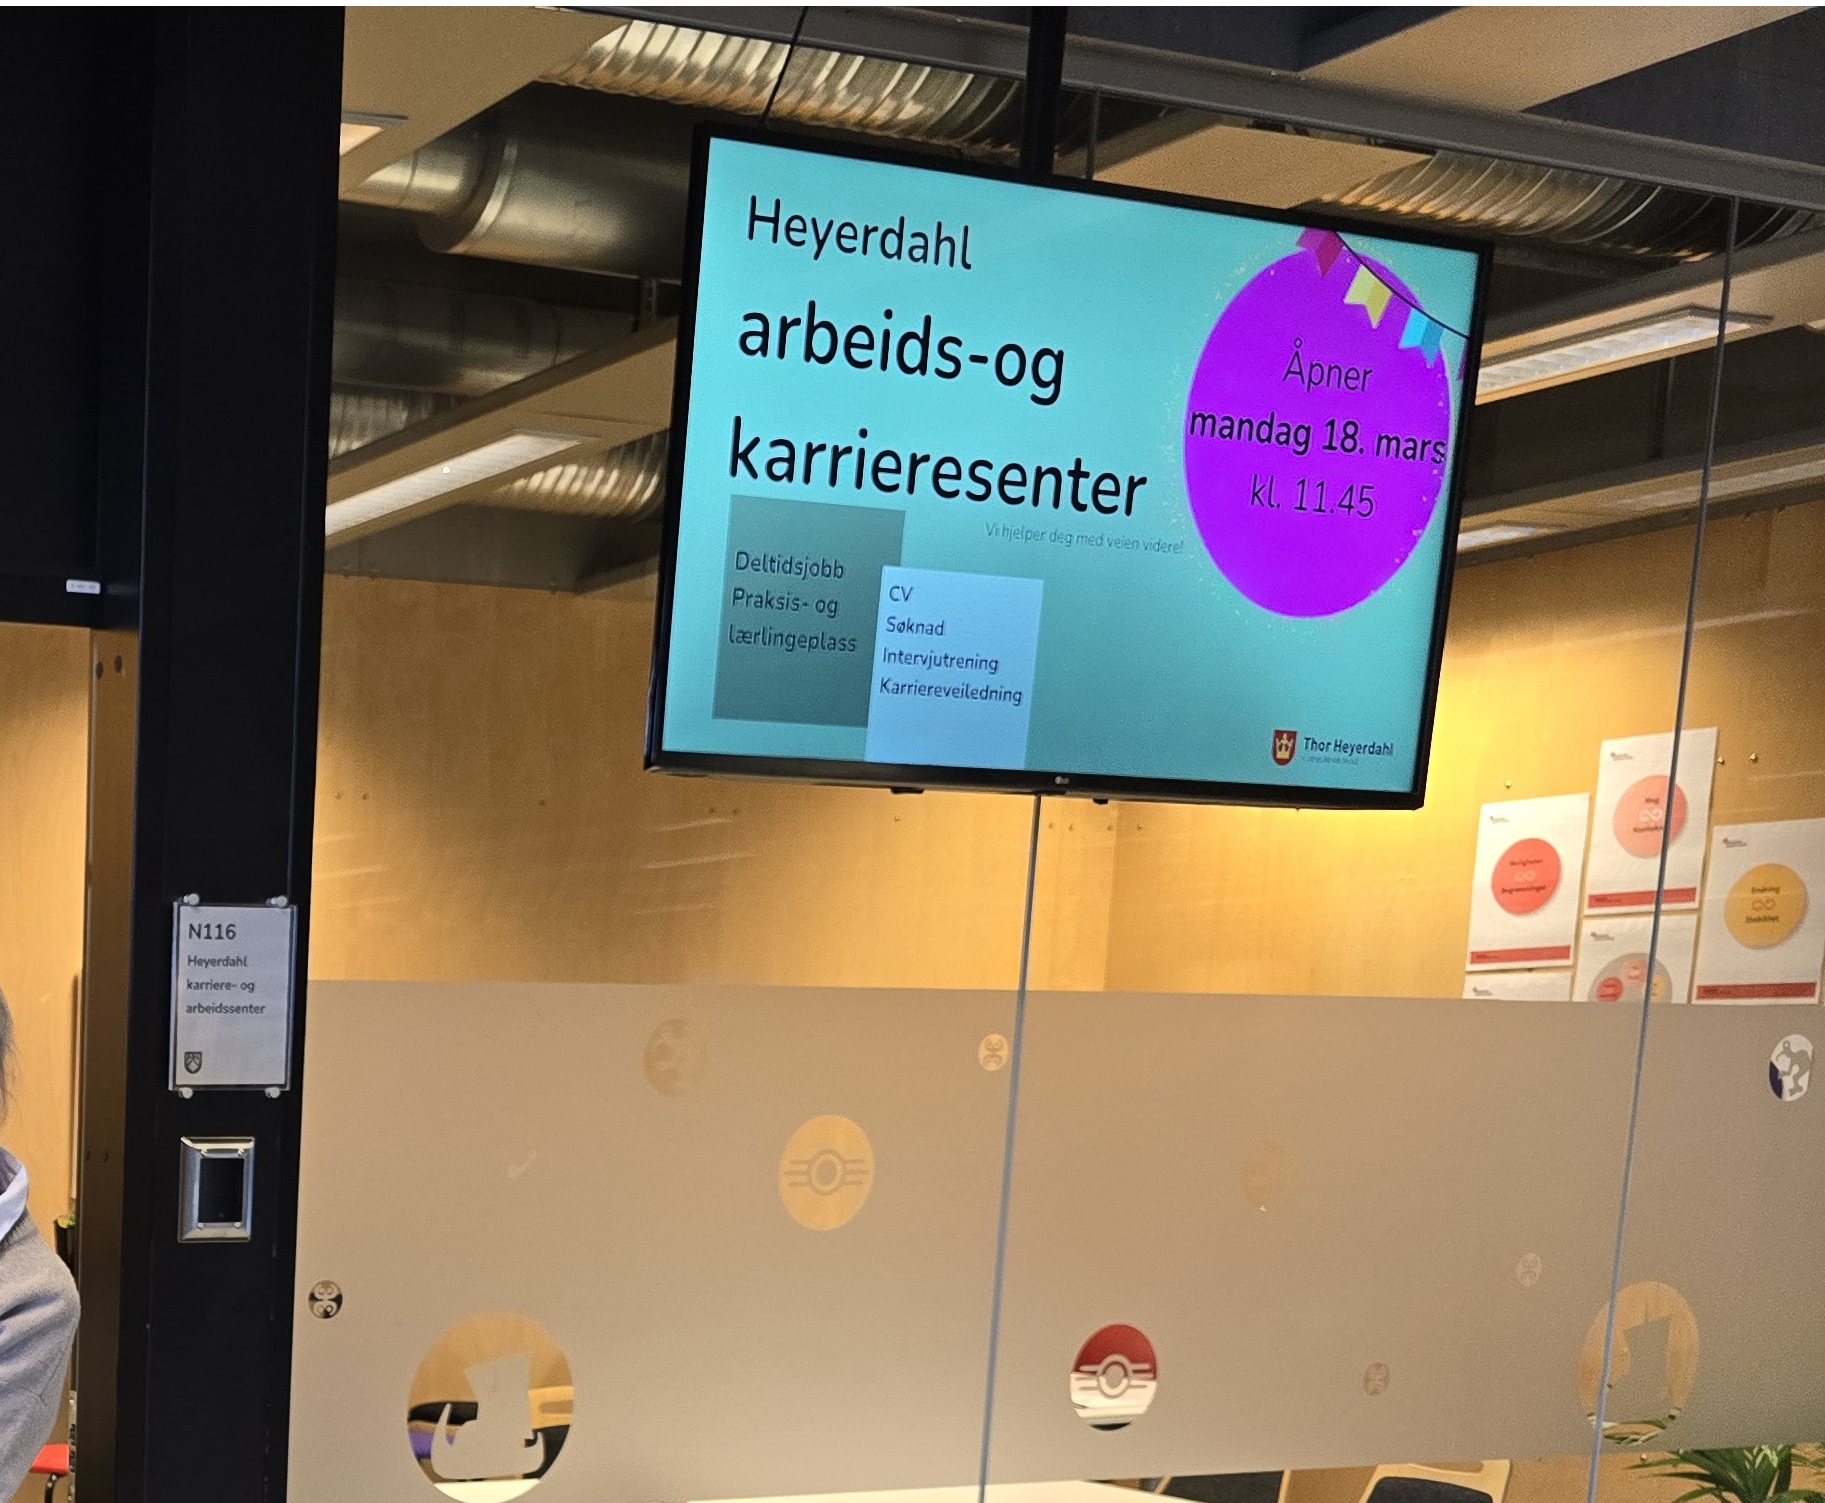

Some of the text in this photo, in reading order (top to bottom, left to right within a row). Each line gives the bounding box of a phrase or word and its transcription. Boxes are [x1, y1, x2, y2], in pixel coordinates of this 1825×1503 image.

[746, 194, 973, 271] Heyerdahl
[737, 299, 1066, 407] arbeids-og
[1282, 337, 1373, 393] Åpner
[1189, 411, 1446, 465] mandag 18. mars
[728, 415, 1149, 518] karrieresenter
[1251, 473, 1374, 518] kl. 11.45
[985, 521, 1000, 537] Vi
[1001, 523, 1047, 542] hjelper
[1049, 529, 1073, 548] deg
[1076, 532, 1104, 547] med
[1107, 536, 1140, 551] veien
[734, 550, 845, 580] Deltidsjobb
[731, 587, 839, 619] Praksis- og
[888, 585, 914, 602] CV
[728, 623, 858, 653] lærlingeplass
[885, 616, 945, 637] Søknad
[882, 647, 999, 675] Intervjutrening
[879, 677, 1023, 707] Karriereveiledning
[1304, 737, 1393, 757] Thor Heyerdahl
[188, 923, 237, 940] N116
[186, 954, 248, 969] Heyerdahl
[186, 978, 256, 994] karriere- og
[185, 1001, 266, 1015] arbeidssenter
